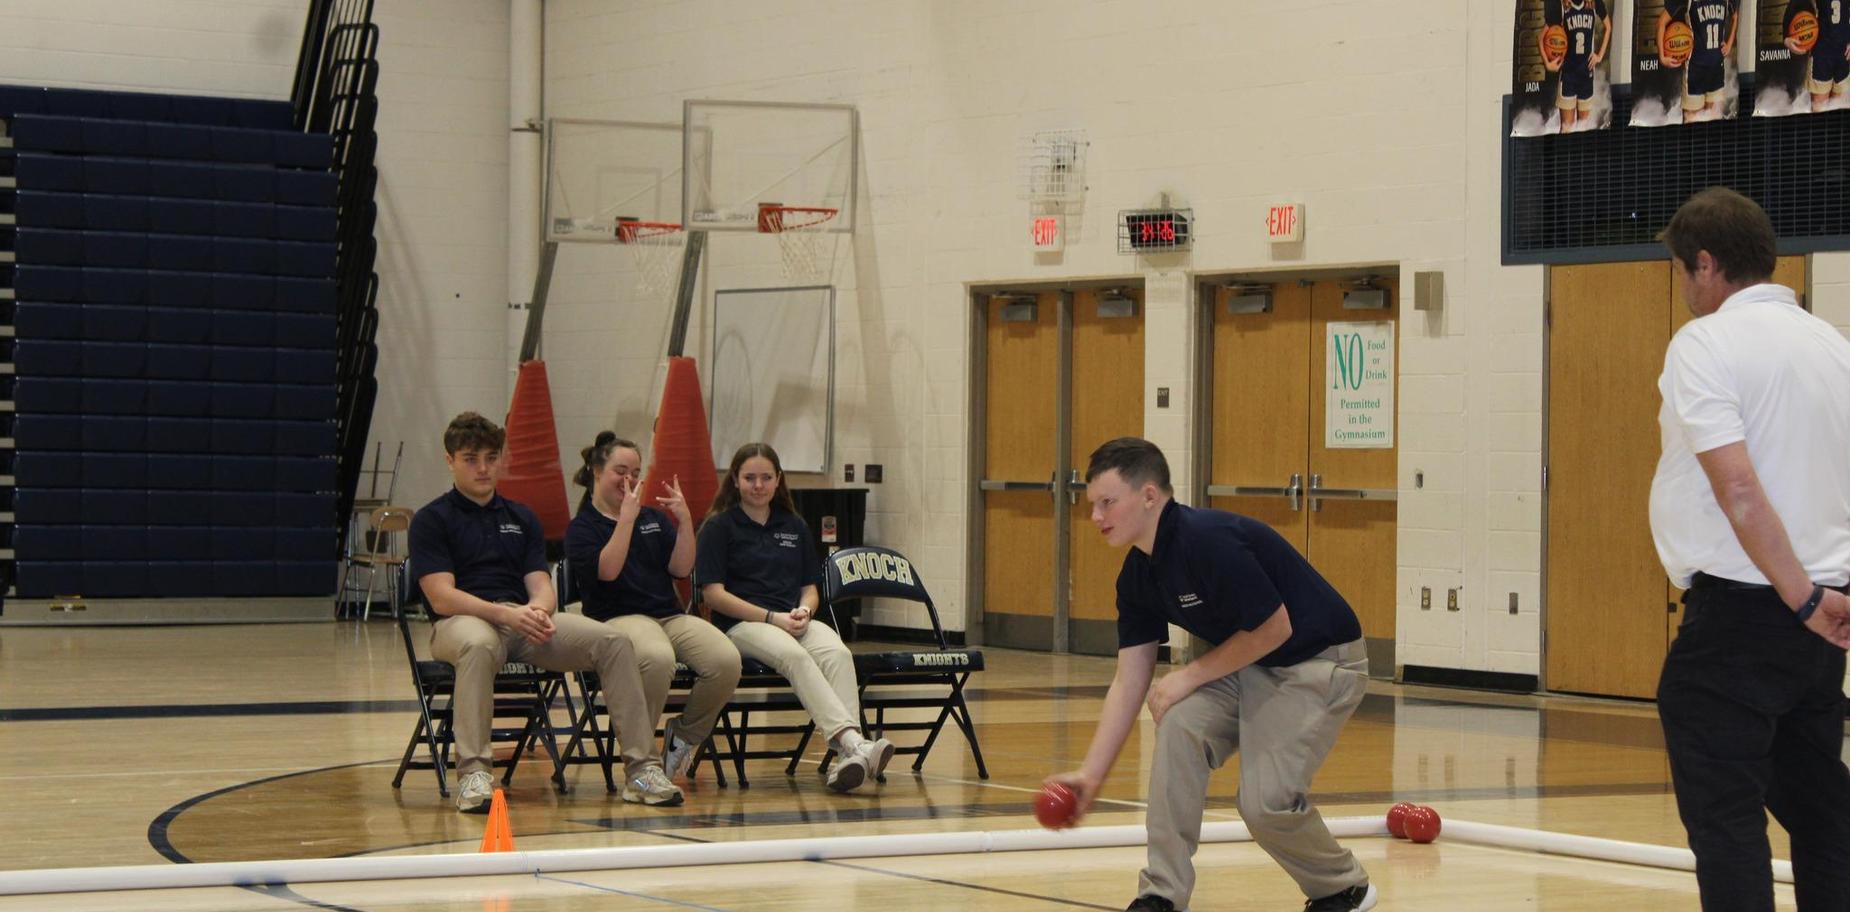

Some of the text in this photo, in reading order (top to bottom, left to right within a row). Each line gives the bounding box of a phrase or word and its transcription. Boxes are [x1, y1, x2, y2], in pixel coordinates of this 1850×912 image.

[1697, 4, 1726, 23] KNOCH
[1831, 0, 1841, 25] 3
[1566, 14, 1594, 31] KNOCH
[1575, 31, 1585, 55] 2
[1706, 23, 1719, 50] 11
[1760, 49, 1791, 62] SAVANNA
[1640, 60, 1659, 71] NEAH
[1269, 206, 1294, 236] EXIT
[1034, 218, 1056, 246] EXIT
[1367, 340, 1386, 350] Food
[1333, 333, 1364, 391] NO
[1372, 357, 1381, 365] or
[1365, 370, 1388, 380] Drink
[1340, 398, 1381, 409] Permitted
[1348, 413, 1372, 425] in the
[1334, 428, 1386, 442] Gymnasium
[835, 552, 914, 586] KNOCH
[912, 652, 969, 666] KNIGHTS
